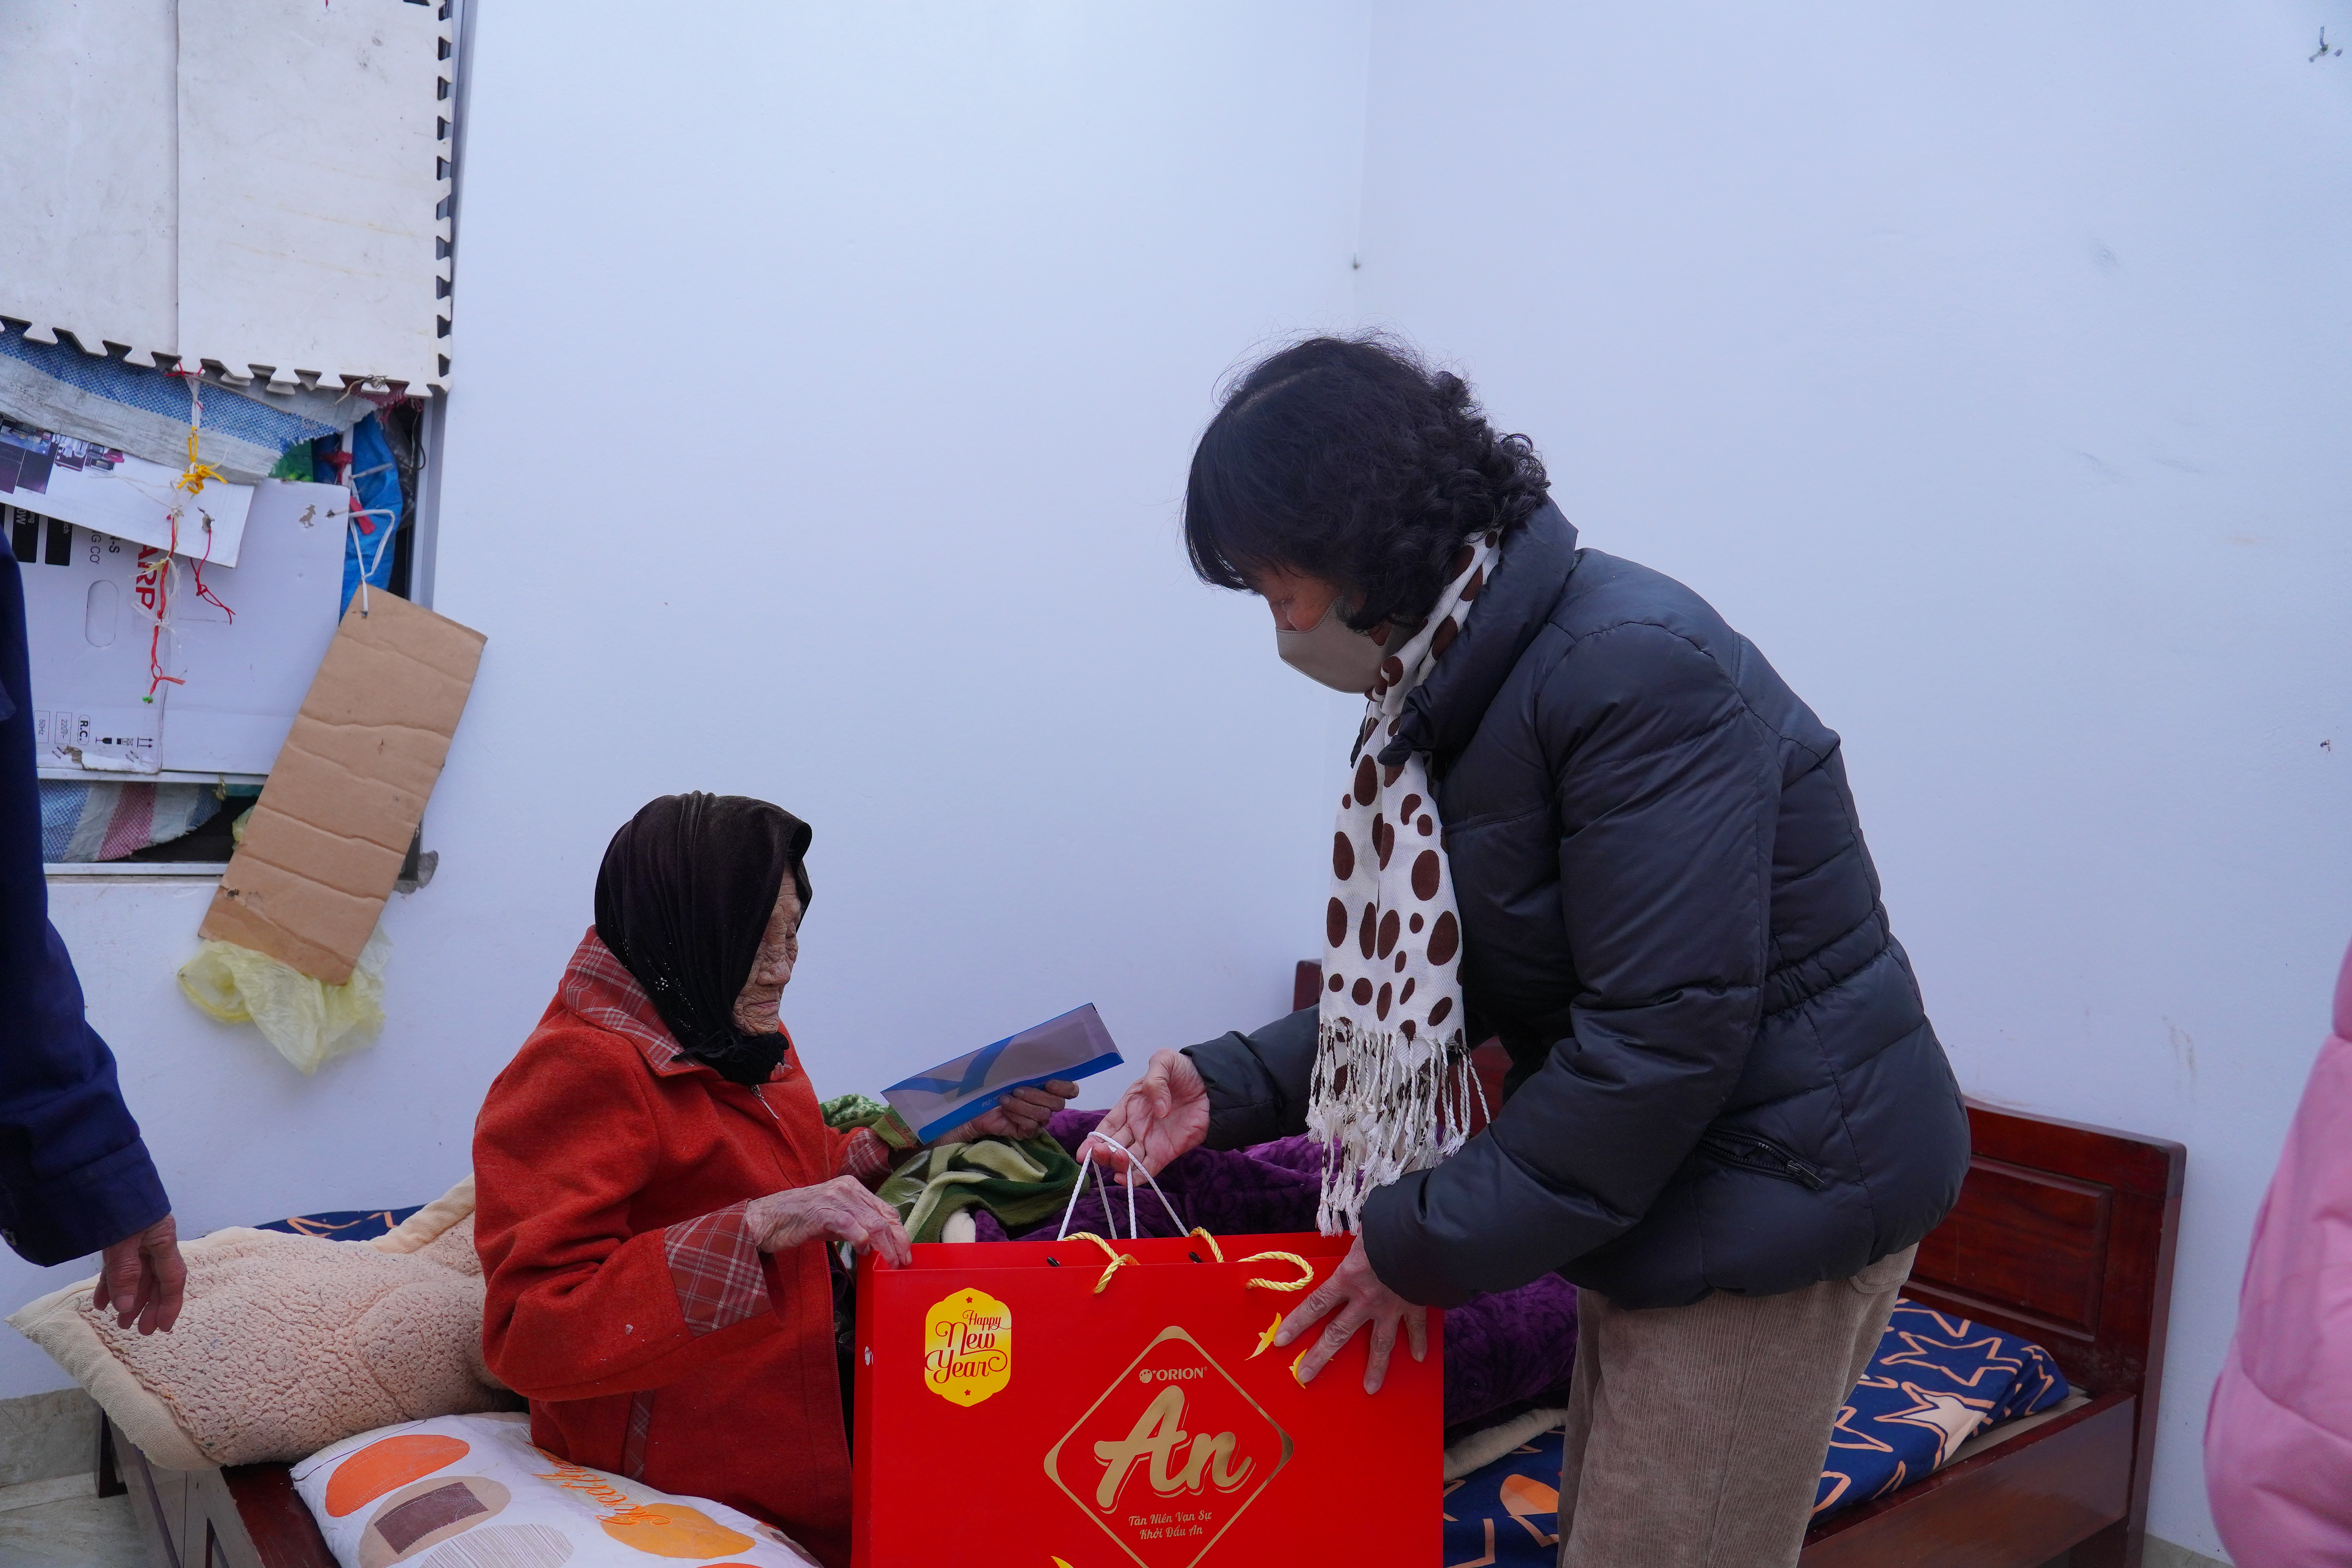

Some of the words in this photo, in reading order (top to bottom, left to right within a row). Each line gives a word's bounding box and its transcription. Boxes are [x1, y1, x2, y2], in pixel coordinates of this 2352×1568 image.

[136, 544, 158, 610] ARP
[79, 720, 89, 741] R.C.
[962, 1310, 1011, 1330] Happy
[935, 1321, 1008, 1360] New
[925, 1349, 991, 1383] Year
[1156, 1367, 1203, 1381] ORION
[1094, 1385, 1256, 1514] An
[1129, 1515, 1148, 1526] Tân
[1150, 1513, 1173, 1524] Niên
[1175, 1512, 1196, 1523] Vạn
[1198, 1510, 1212, 1521] Sự
[1140, 1528, 1163, 1539] Khởi
[1165, 1525, 1186, 1537] Đầu
[1189, 1524, 1203, 1537] An
